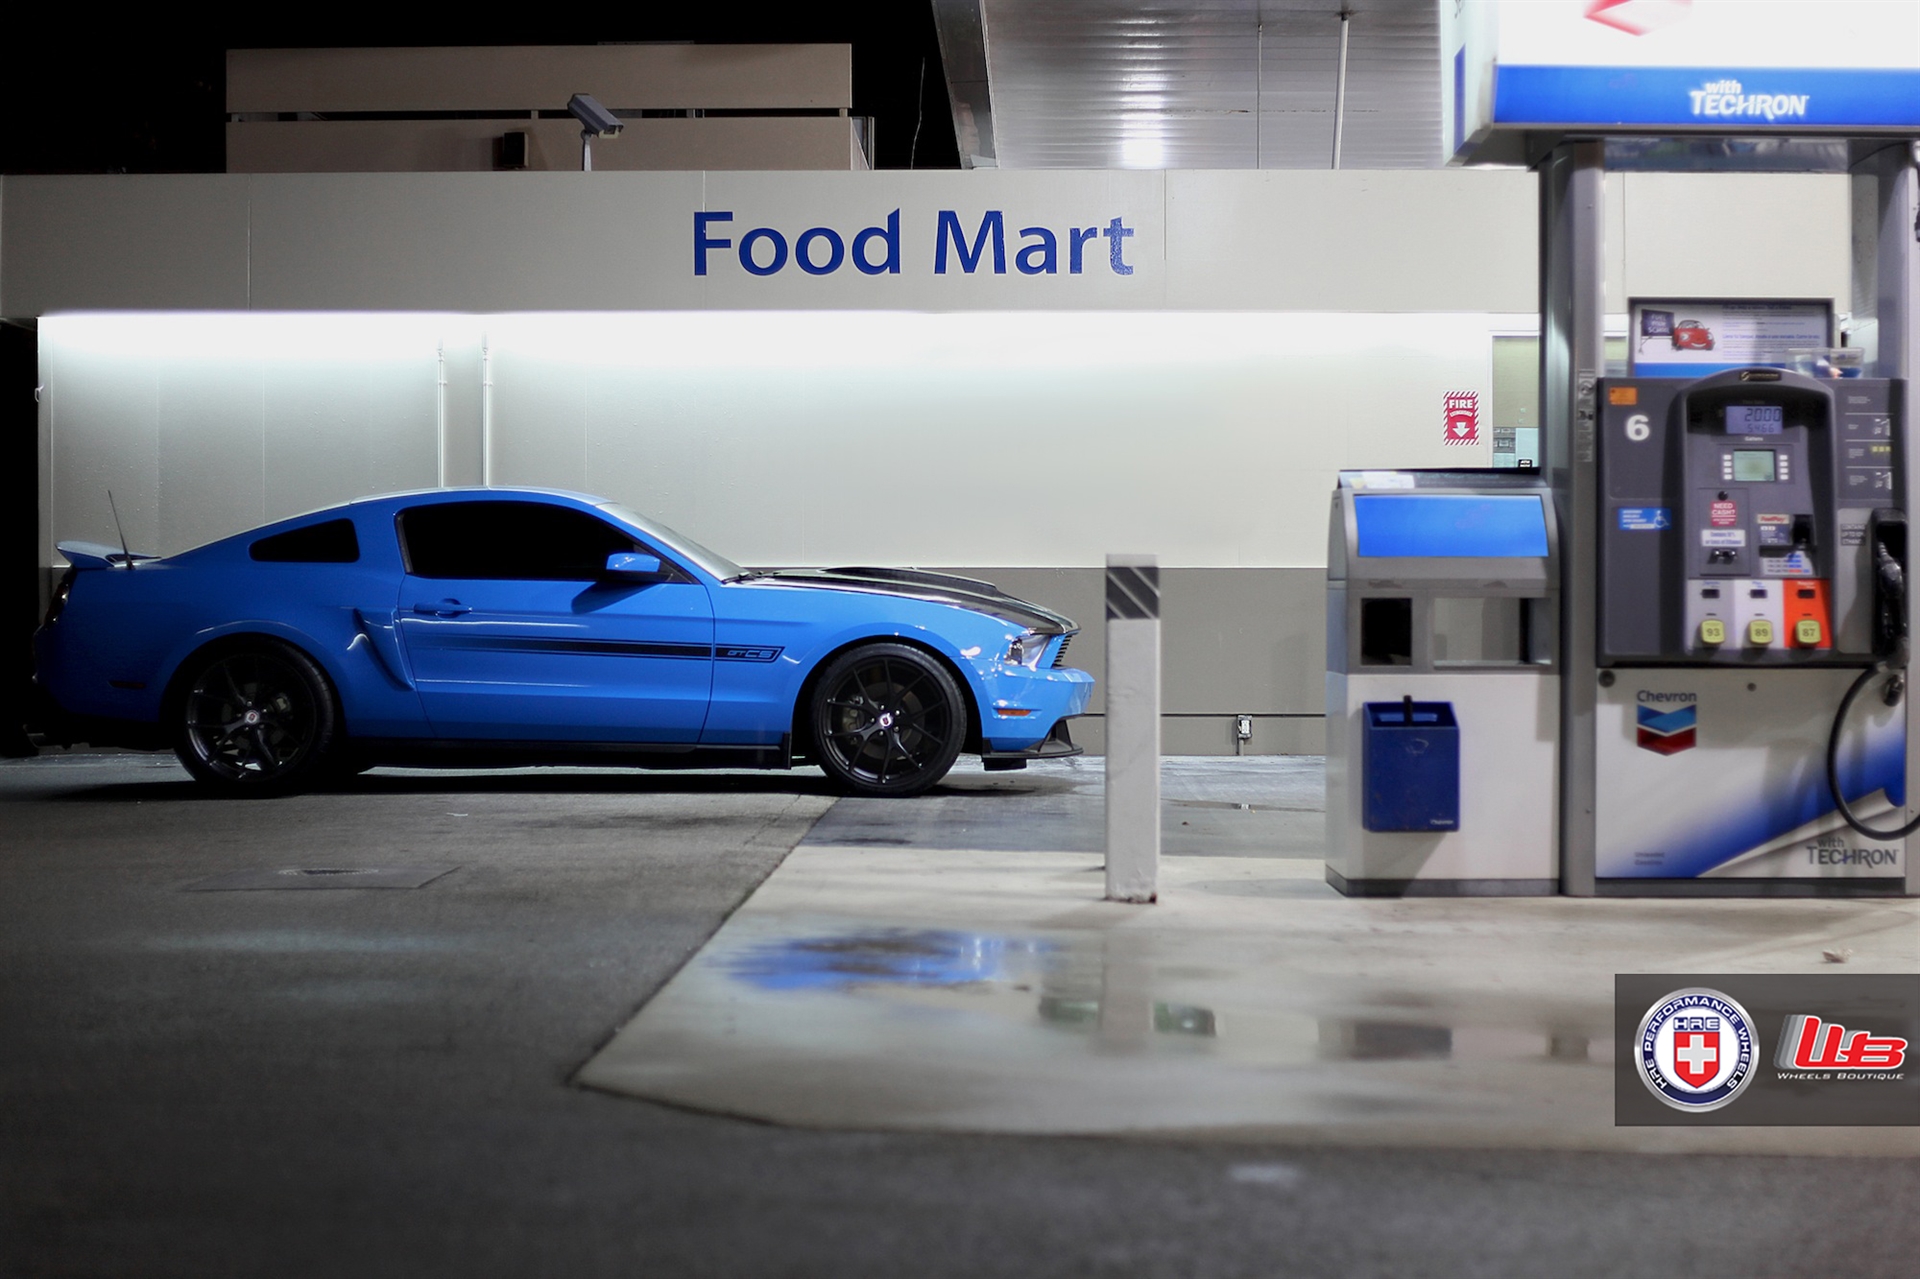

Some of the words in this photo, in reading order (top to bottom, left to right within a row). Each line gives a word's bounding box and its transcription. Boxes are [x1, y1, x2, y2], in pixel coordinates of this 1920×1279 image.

[1704, 79, 1742, 94] with
[1689, 90, 1808, 120] TECHRON
[693, 207, 901, 276] Food
[933, 209, 1135, 276] Mart
[1448, 399, 1474, 409] FIRE
[1626, 414, 1650, 441] 6
[1706, 628, 1720, 637] 93
[1754, 628, 1769, 637] 89
[1802, 628, 1816, 637] 87
[1637, 690, 1697, 702] Chevron
[1817, 837, 1845, 848] with
[1806, 846, 1898, 869] TECHRON
